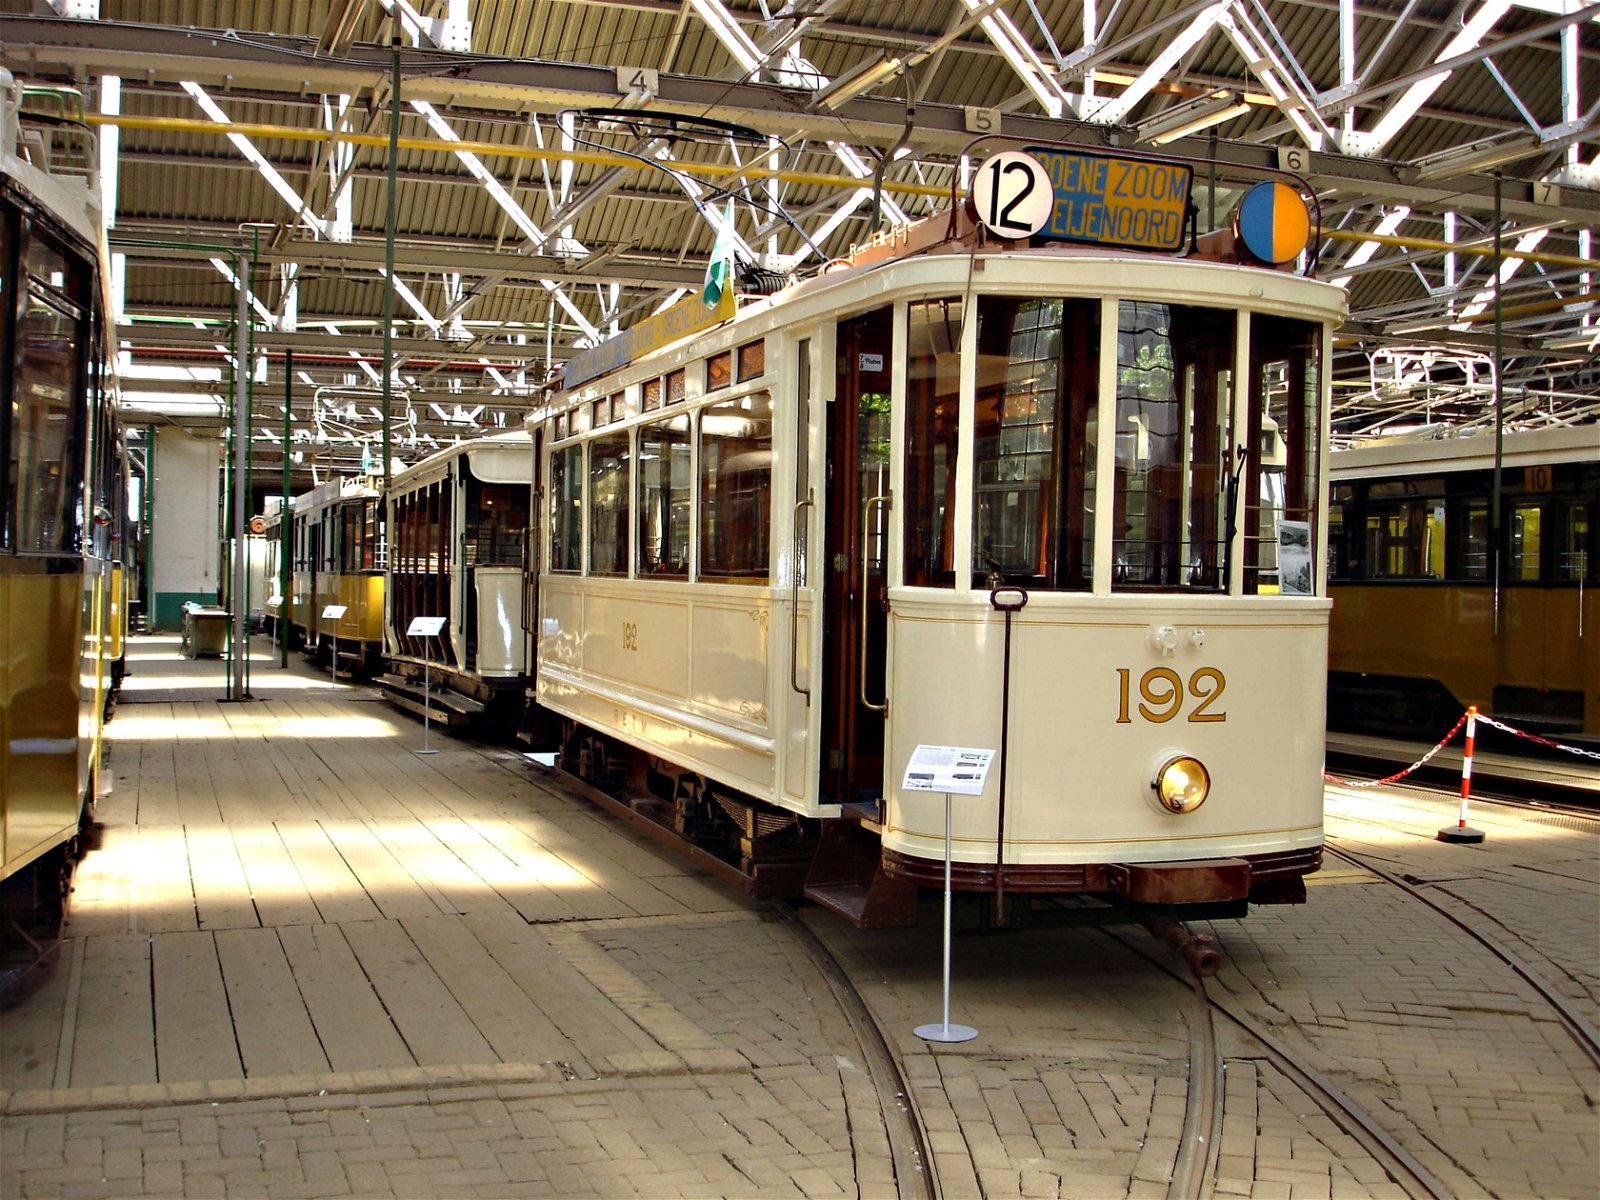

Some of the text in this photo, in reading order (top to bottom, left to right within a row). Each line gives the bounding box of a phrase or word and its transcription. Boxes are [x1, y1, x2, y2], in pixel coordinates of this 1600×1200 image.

[629, 70, 647, 95] 4
[976, 110, 992, 130] 5
[1287, 151, 1301, 170] 6
[1113, 161, 1188, 203] ZOOM
[1542, 184, 1551, 202] 7
[989, 158, 1035, 232] 12
[1530, 468, 1547, 490] 10
[622, 621, 638, 651] 192
[1116, 666, 1226, 723] 192
